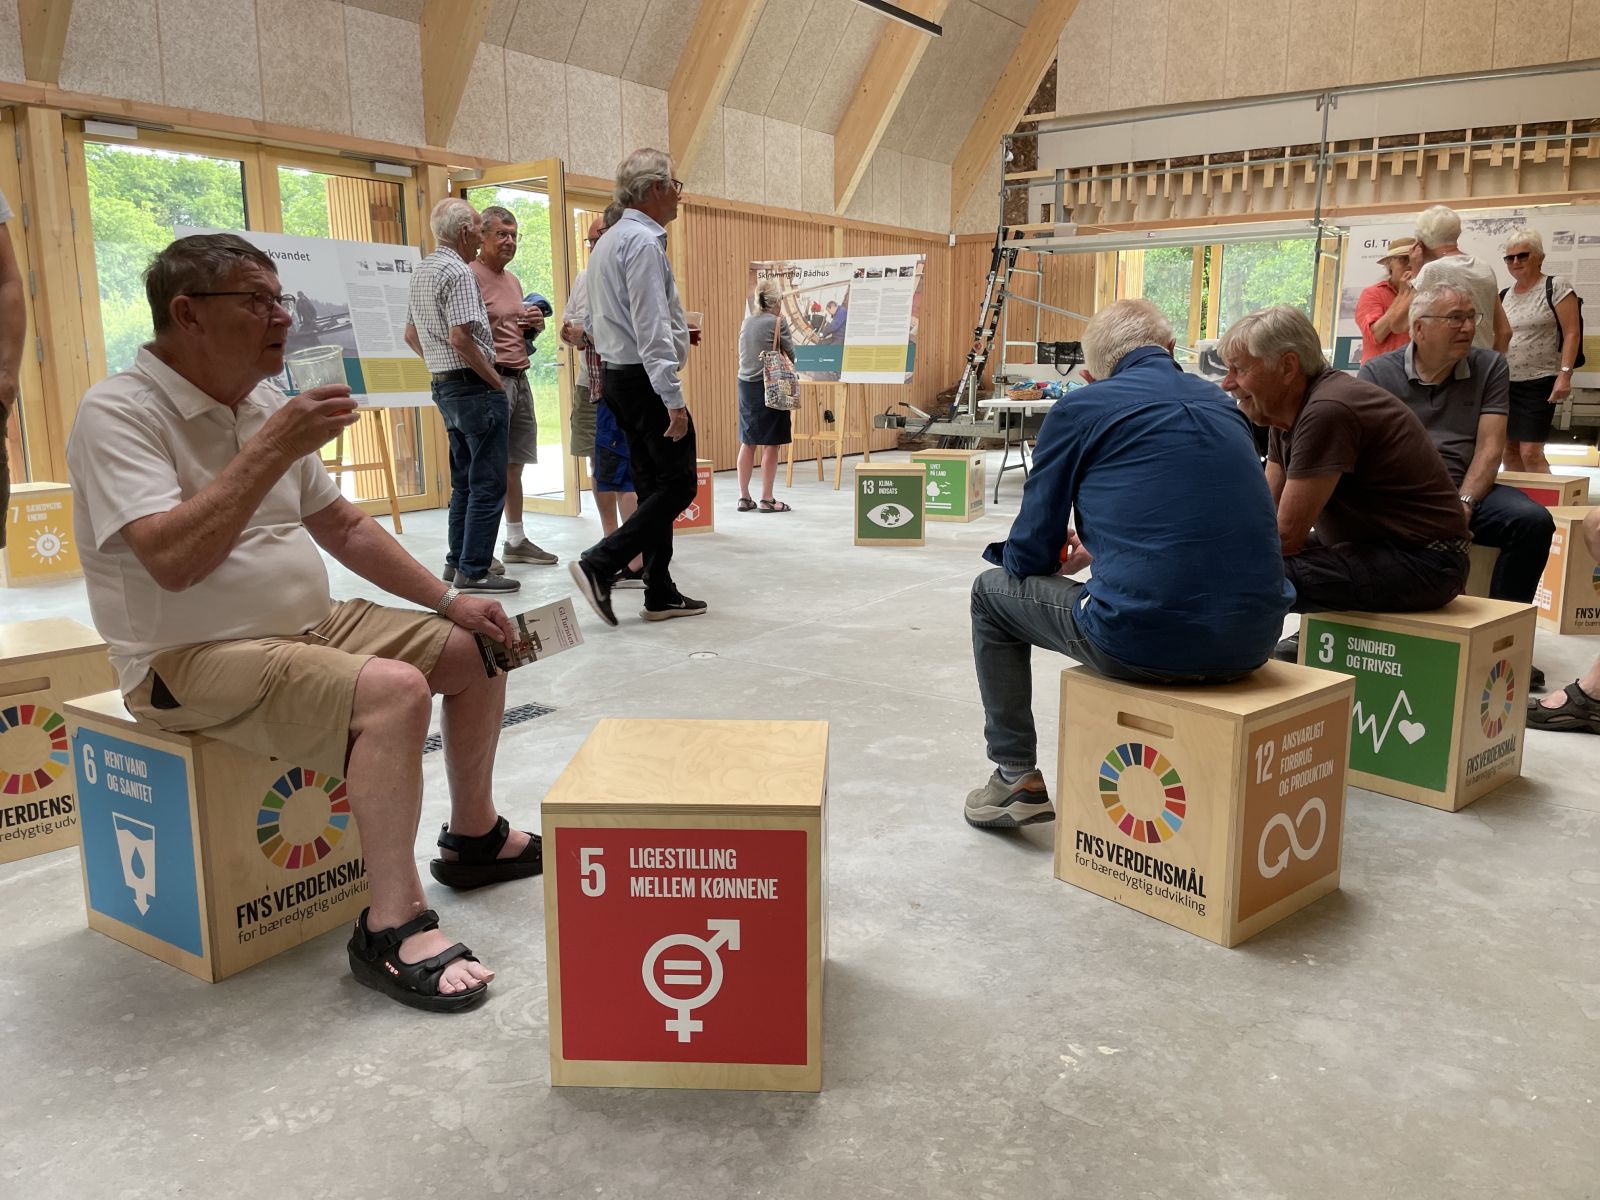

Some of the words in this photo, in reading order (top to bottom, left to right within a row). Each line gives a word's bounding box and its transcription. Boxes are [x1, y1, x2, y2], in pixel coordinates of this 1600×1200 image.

[264, 249, 311, 262] kvandet
[803, 269, 830, 278] Bådhus
[862, 480, 875, 495] 13
[11, 506, 19, 524] 7
[1575, 607, 1594, 619] FN'S
[1318, 632, 1335, 663] 3
[1347, 636, 1396, 657] SUNDHED
[1346, 654, 1361, 669] OG
[1361, 656, 1403, 677] TRIVSEL
[1281, 720, 1325, 753] ANSVARLIGT
[83, 744, 98, 785] 6
[104, 749, 124, 771] RENT
[125, 755, 148, 778] VAND
[1255, 740, 1275, 784] 12
[1280, 746, 1313, 775] FORBRUG
[107, 773, 119, 792] OG
[120, 777, 153, 804] SANITET
[1279, 778, 1290, 797] OG
[1290, 760, 1334, 792] PRODUKTION
[55, 815, 77, 829] udv
[580, 848, 606, 897] 5
[629, 847, 737, 870] LIGESTILLING
[1076, 830, 1105, 858] FN'S
[1106, 841, 1207, 898] VERDENSMÅL
[236, 894, 273, 928] FN'S
[273, 857, 367, 912] VERDENSM
[630, 877, 696, 898] MELLEM
[701, 878, 779, 900] KØNNENE
[1075, 852, 1090, 868] for
[1091, 858, 1153, 896] bæredygtig
[1155, 885, 1206, 916] udvikling
[238, 930, 257, 944] for
[258, 898, 329, 937] bæredygtig
[330, 880, 369, 905] udvikli
[385, 961, 399, 975] ergo
